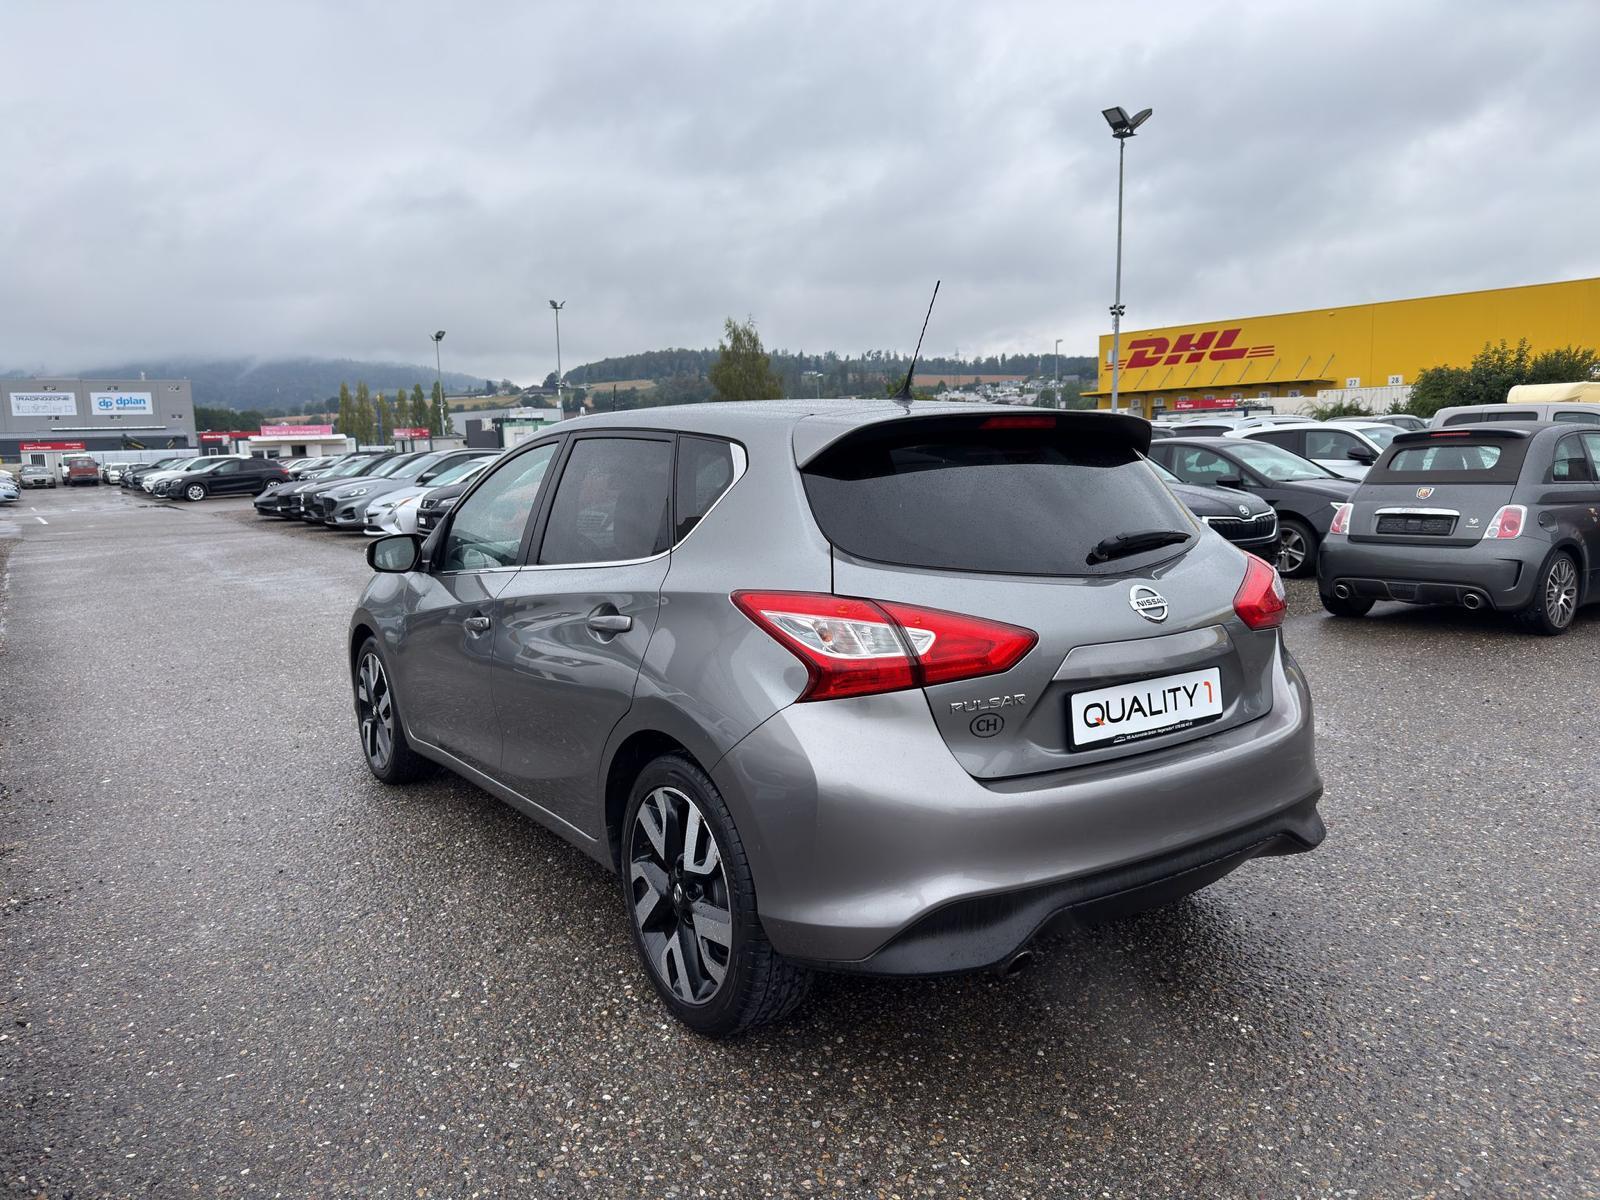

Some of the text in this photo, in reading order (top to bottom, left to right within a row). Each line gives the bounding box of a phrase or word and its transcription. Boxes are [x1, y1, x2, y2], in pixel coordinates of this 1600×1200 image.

[1125, 328, 1249, 369] DHL
[98, 399, 113, 409] dp
[115, 396, 146, 405] dplan
[1136, 597, 1166, 607] NISSAN
[950, 694, 1025, 714] PULSAR
[1083, 683, 1198, 728] QUALITY
[976, 718, 997, 732] CH
